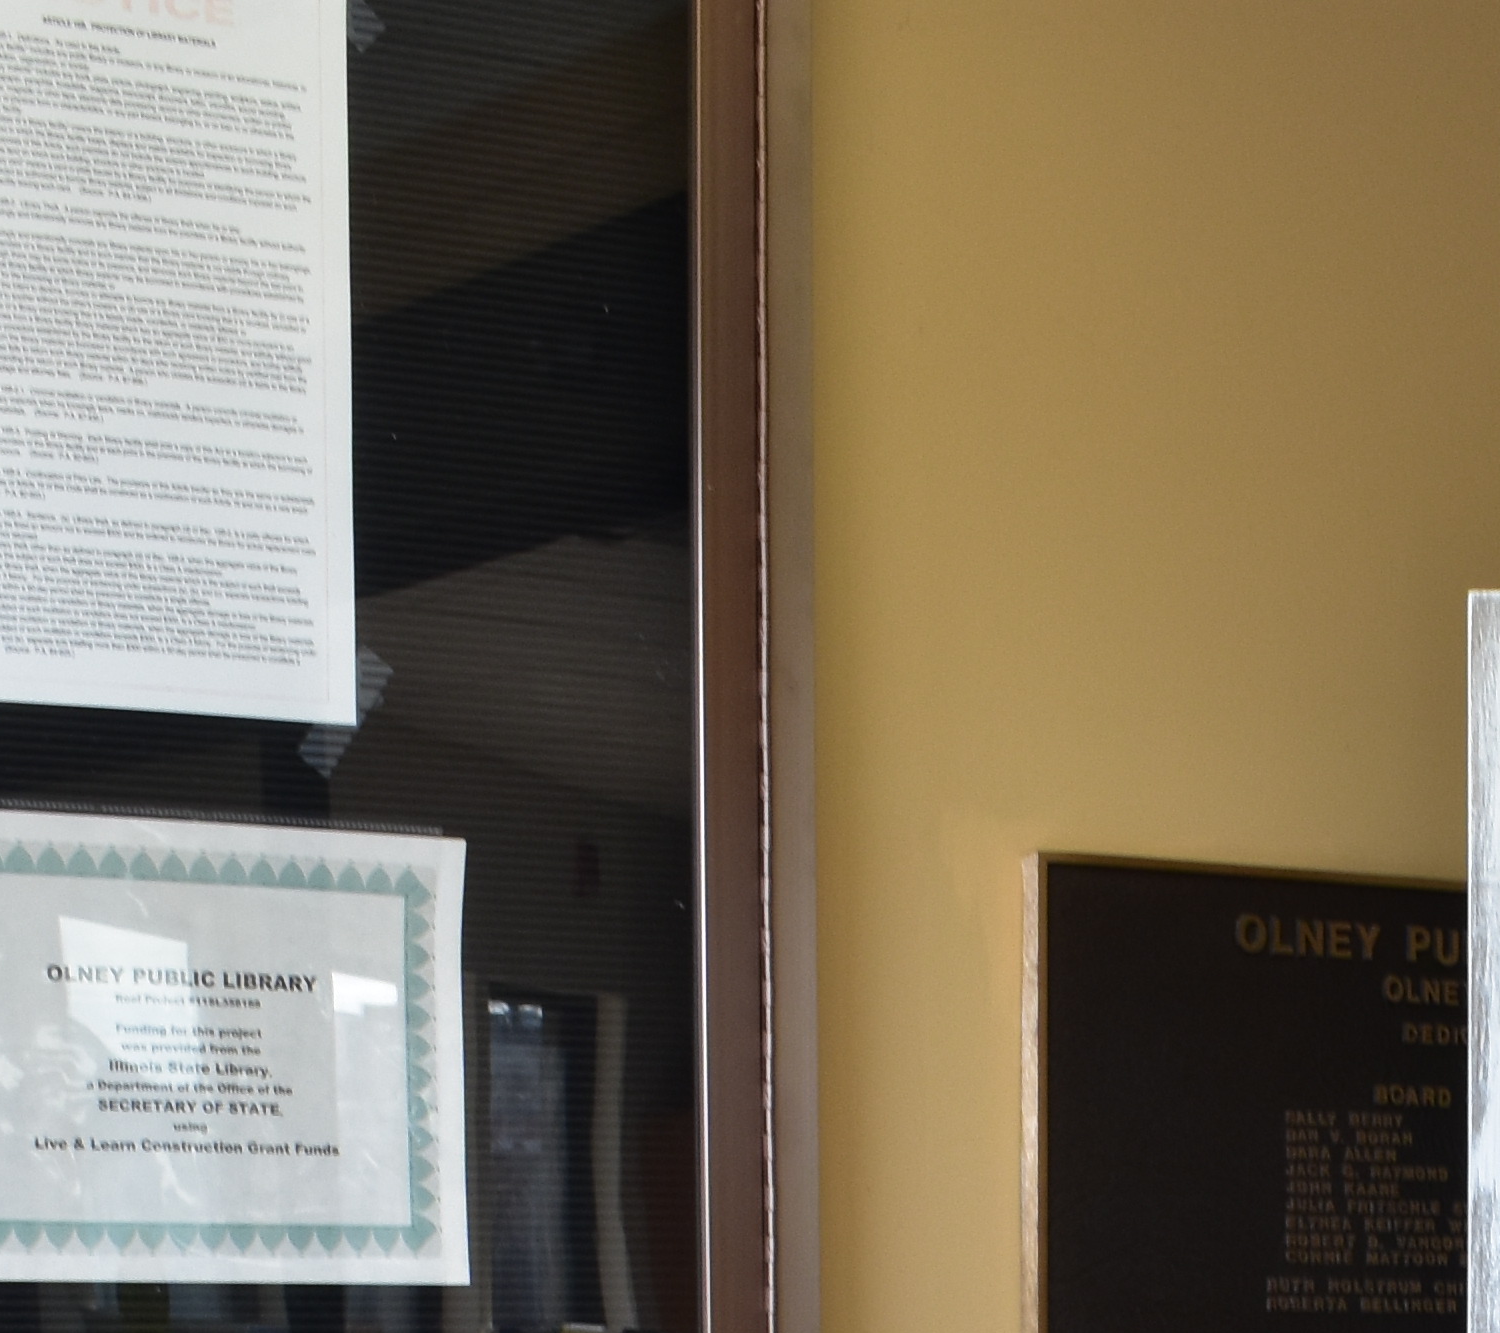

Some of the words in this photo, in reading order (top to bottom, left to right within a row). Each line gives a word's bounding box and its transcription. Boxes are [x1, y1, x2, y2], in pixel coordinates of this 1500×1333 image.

[1234, 911, 1381, 961] OLNEY
[47, 963, 124, 984] OLNEY
[132, 967, 215, 989] PUBLIC
[222, 971, 318, 993] LIBRARY
[1382, 972, 1466, 1007] OLNE
[218, 1027, 263, 1042] project
[109, 1058, 164, 1074] Illinois
[167, 1060, 211, 1076] State
[97, 1079, 173, 1096] Department
[1371, 1083, 1453, 1109] BOARD
[97, 1098, 197, 1114] SECRETARY
[202, 1100, 224, 1115] OF
[34, 1136, 68, 1151] Live
[73, 1137, 85, 1151] &
[90, 1137, 136, 1153] Learn
[141, 1138, 243, 1156] Construction
[246, 1141, 291, 1157] Grant
[294, 1142, 341, 1158] Funds
